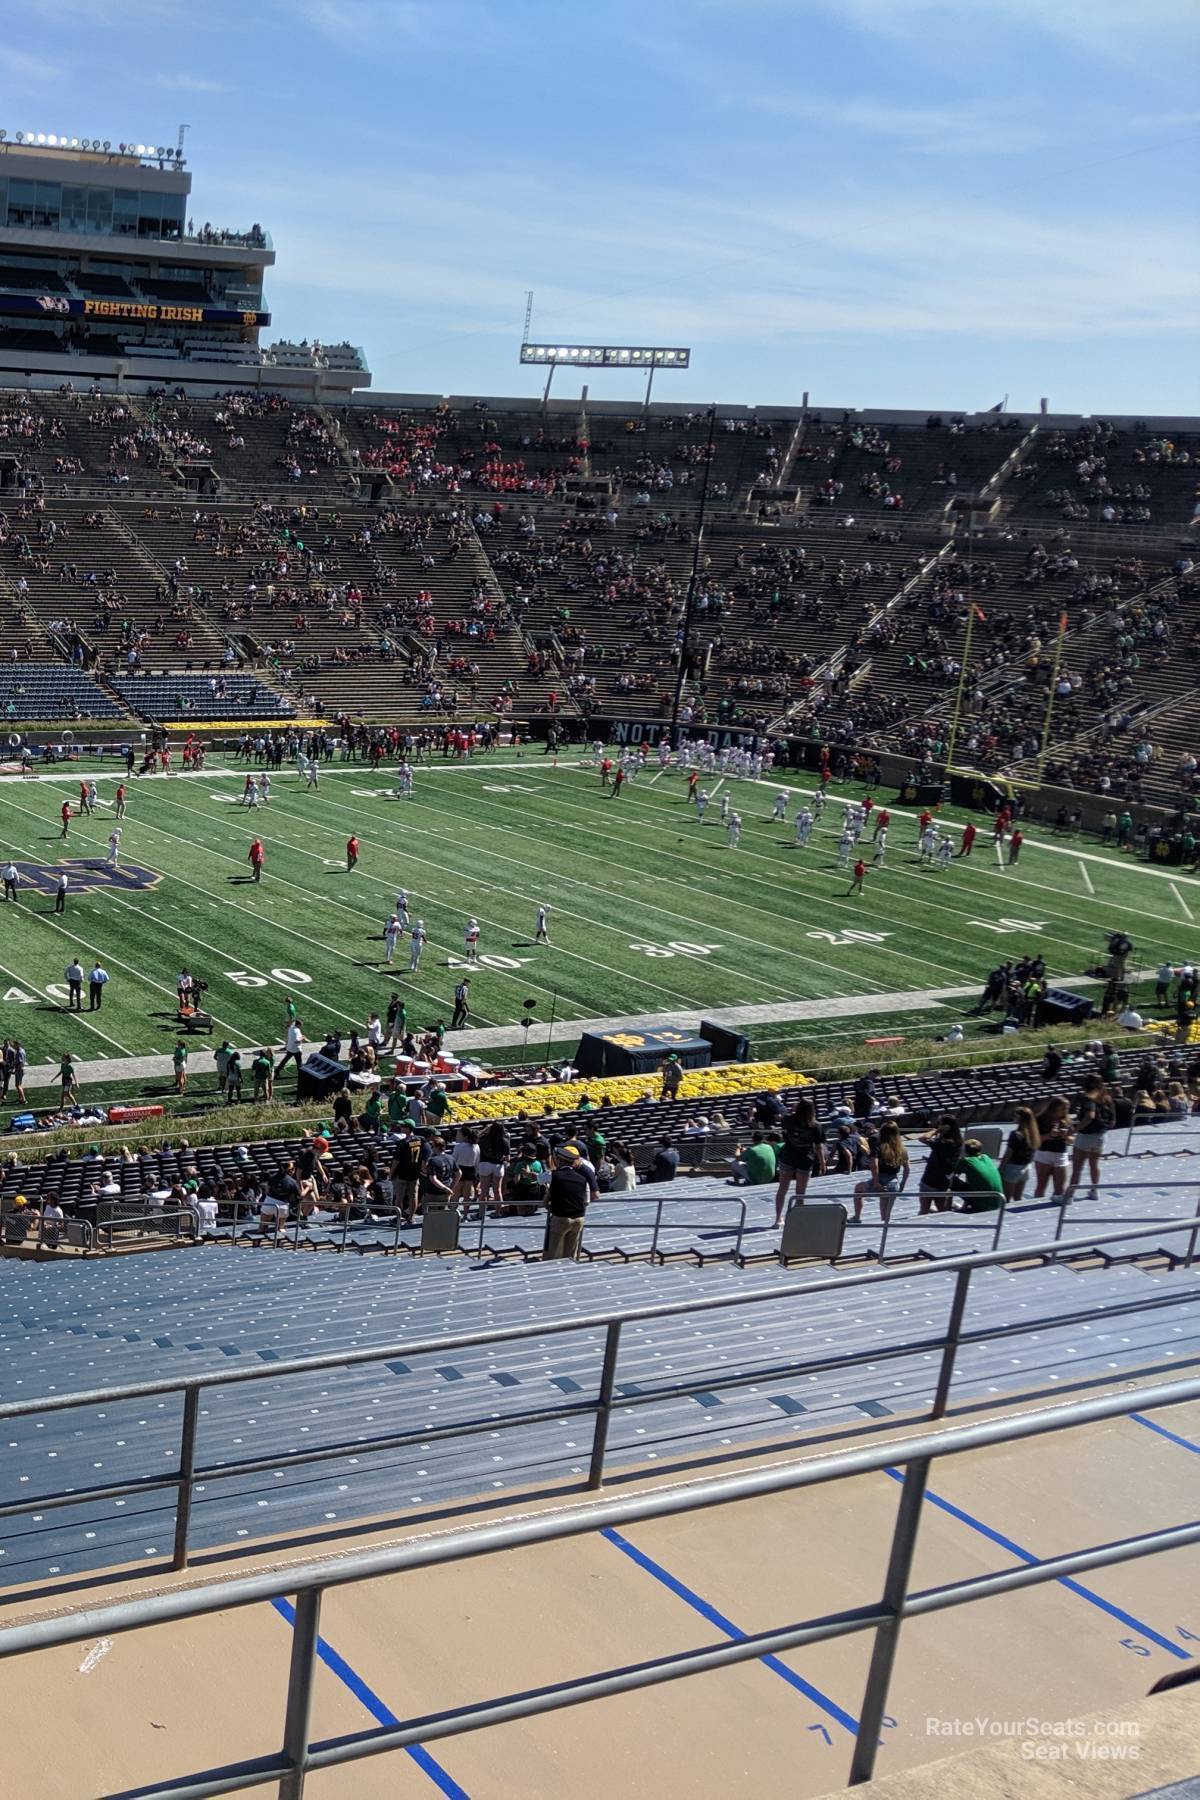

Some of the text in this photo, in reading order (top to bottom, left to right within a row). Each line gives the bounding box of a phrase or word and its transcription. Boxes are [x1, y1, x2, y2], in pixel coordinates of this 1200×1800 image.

[84, 301, 203, 321] FIGHTING IRISH
[615, 722, 690, 747] NOTE
[966, 918, 1043, 933] 10
[806, 928, 885, 945] 20
[629, 941, 711, 957] 30
[224, 968, 312, 987] 50
[1118, 1637, 1151, 1657] 5
